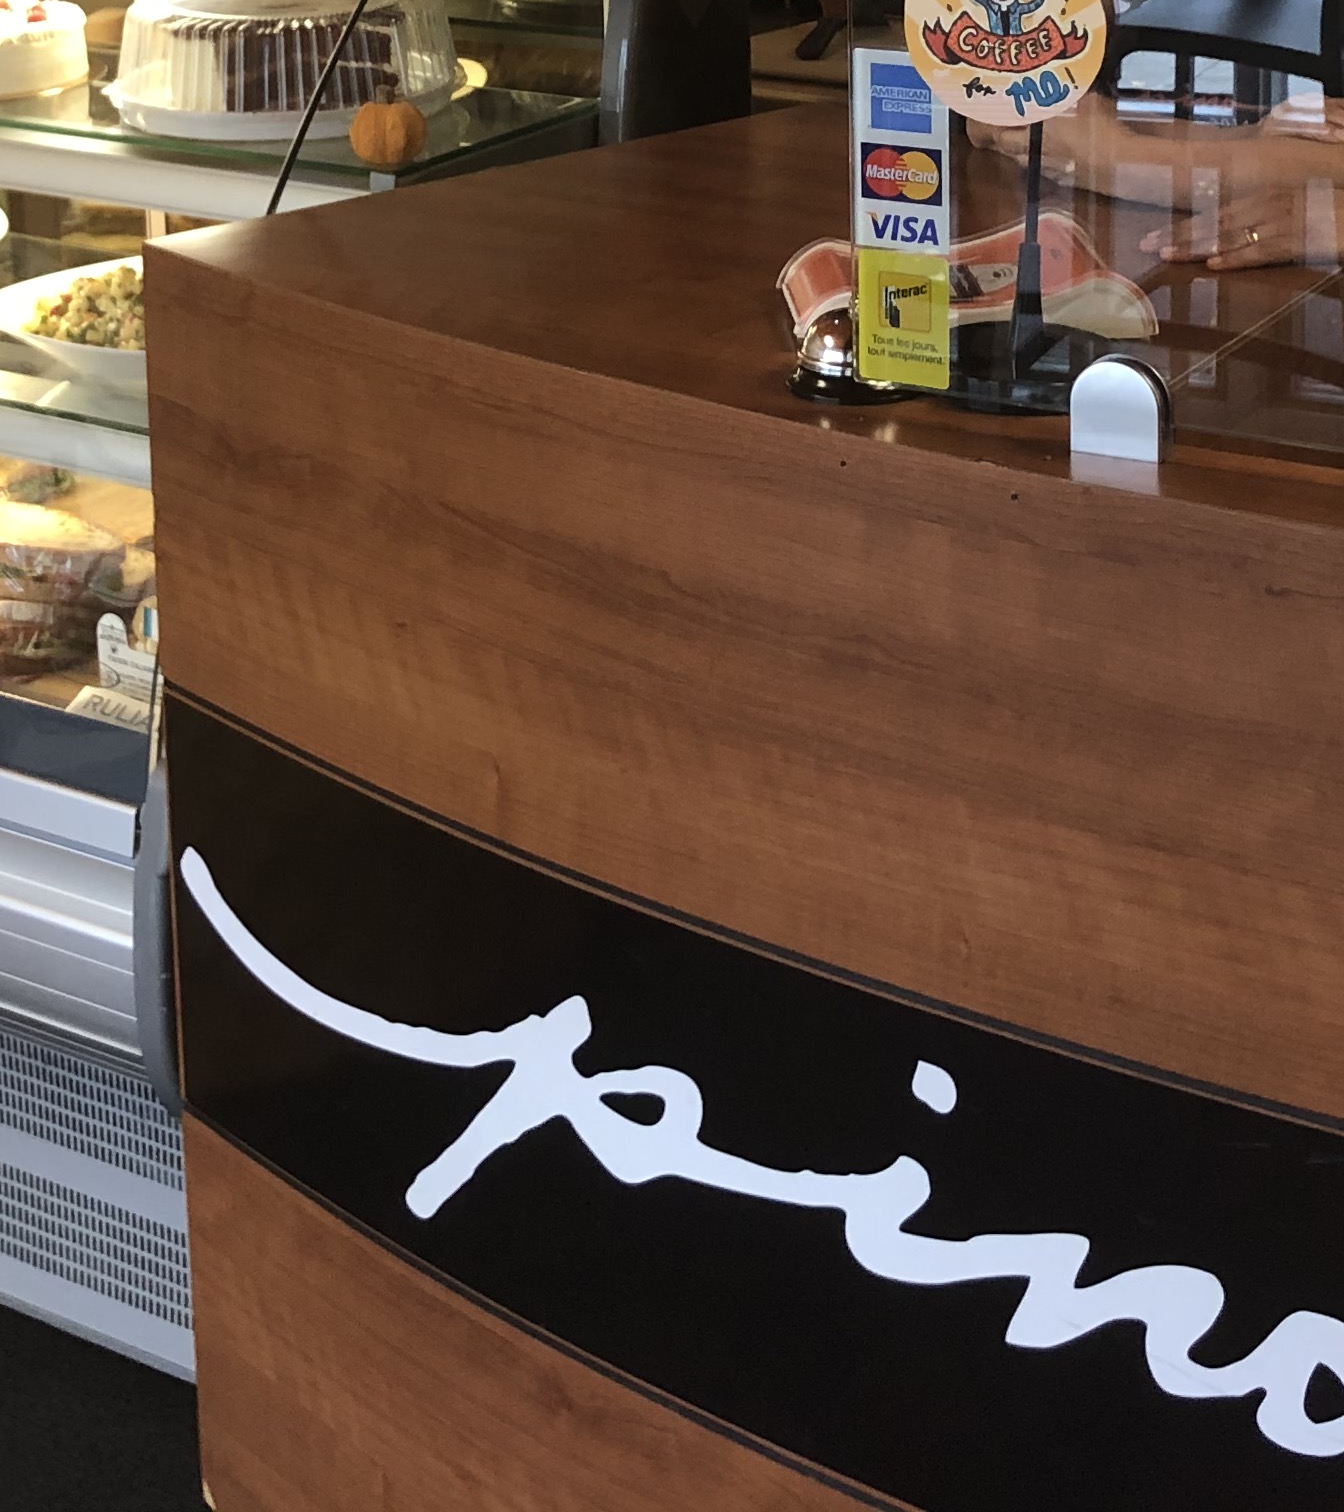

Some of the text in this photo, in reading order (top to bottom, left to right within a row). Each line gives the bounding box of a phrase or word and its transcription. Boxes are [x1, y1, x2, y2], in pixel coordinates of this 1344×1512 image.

[958, 29, 1053, 66] COFFEE
[871, 85, 931, 103] AMERICAN
[882, 100, 933, 114] EXPRESS
[866, 162, 939, 186] MasterCard
[868, 212, 940, 247] VISA
[884, 282, 928, 305] Interac
[872, 332, 894, 348] Tous
